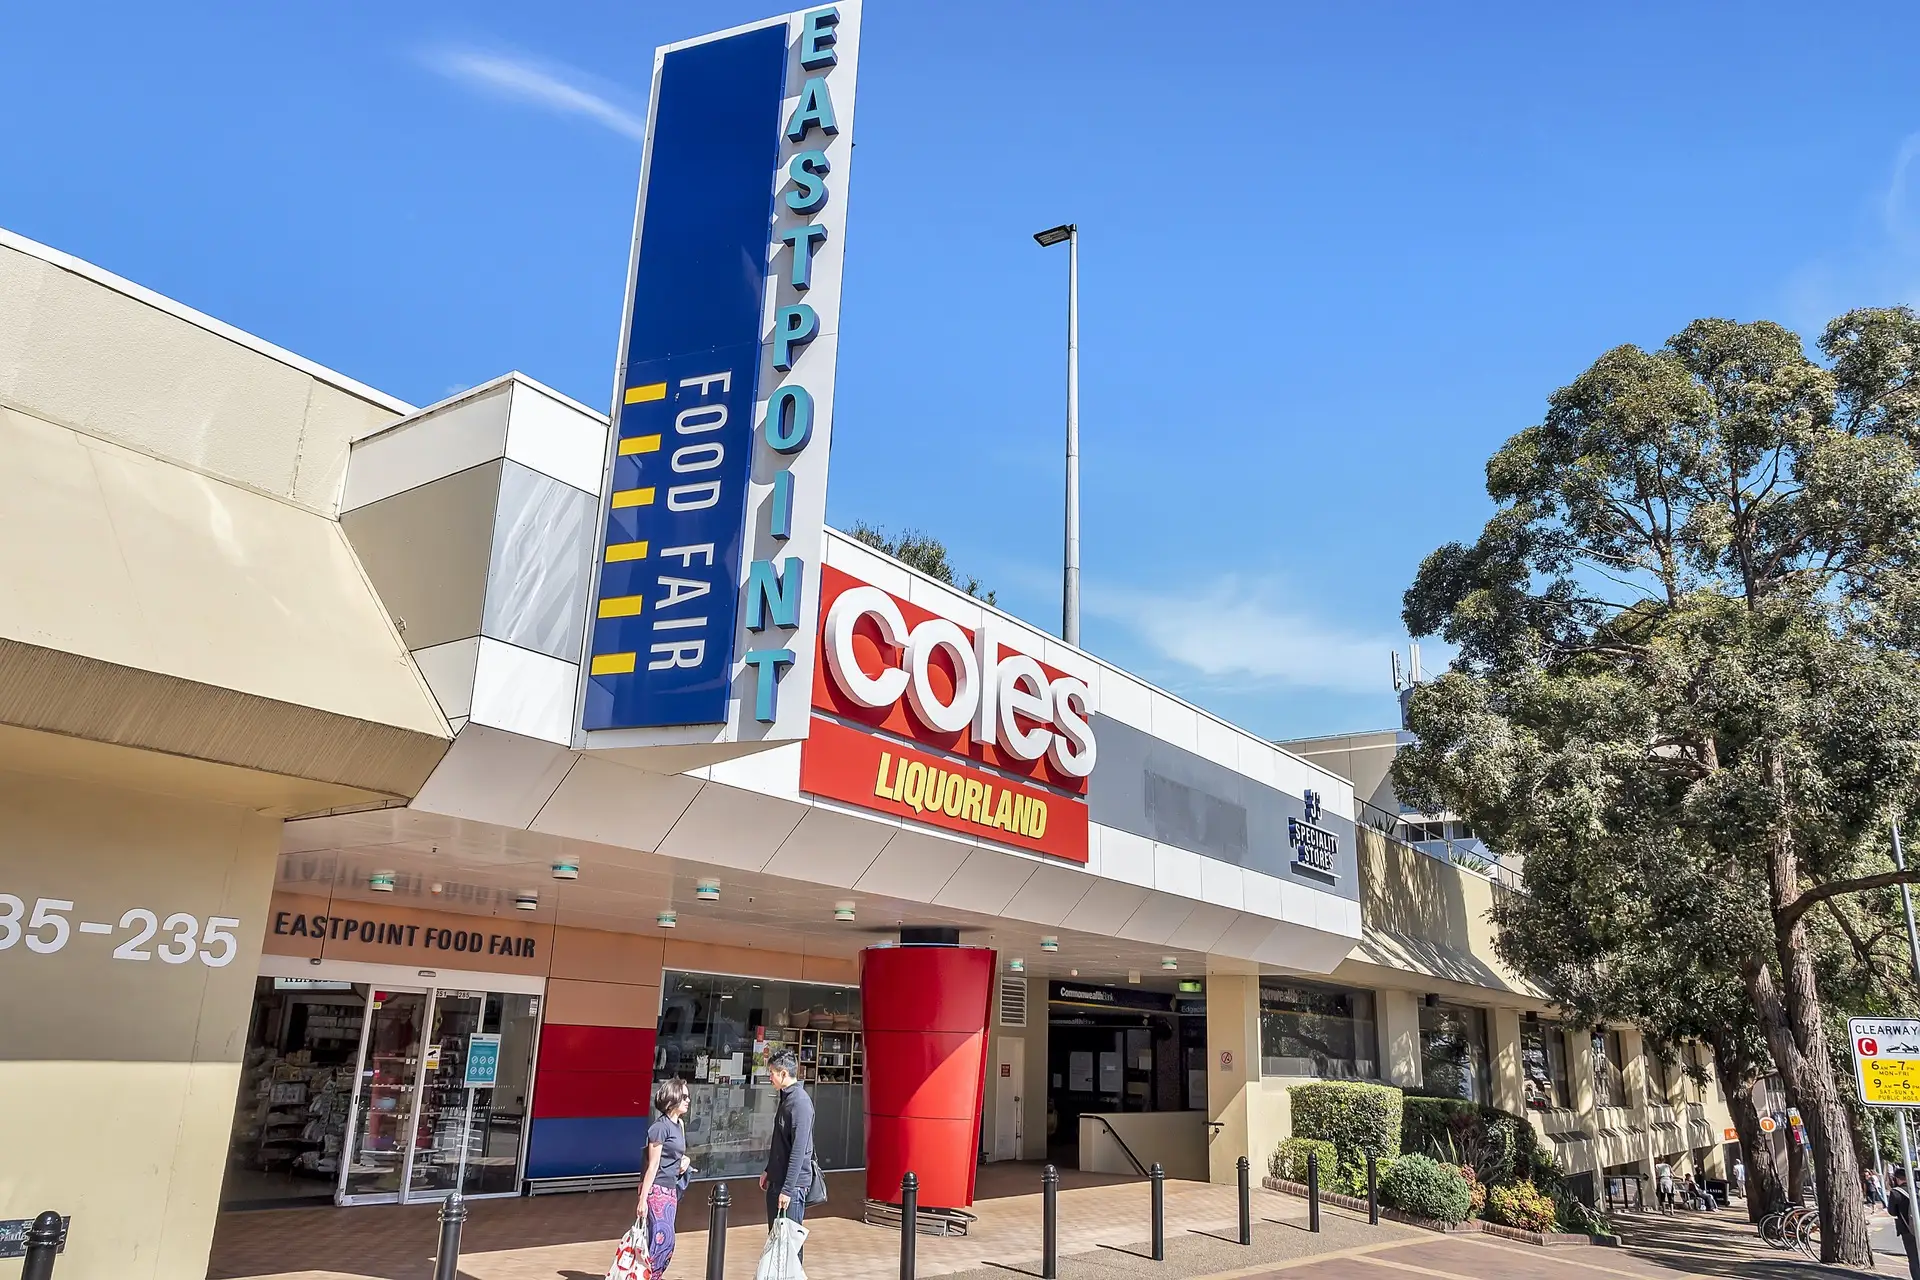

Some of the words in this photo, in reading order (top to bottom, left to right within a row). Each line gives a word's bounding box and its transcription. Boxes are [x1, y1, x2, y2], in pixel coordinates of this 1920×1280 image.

[745, 6, 840, 723] EASTPOINT
[667, 370, 732, 512] FOOD
[648, 543, 715, 671] FAIR
[825, 585, 1097, 778] coles
[874, 751, 1048, 840] LIQUORLAND
[1303, 844, 1334, 870] STORES
[274, 911, 420, 947] EASTPOINT
[424, 927, 483, 953] FOOD
[488, 934, 536, 958] FAIR
[1855, 1024, 1919, 1036] CLEARWAY
[1861, 1039, 1874, 1055] C
